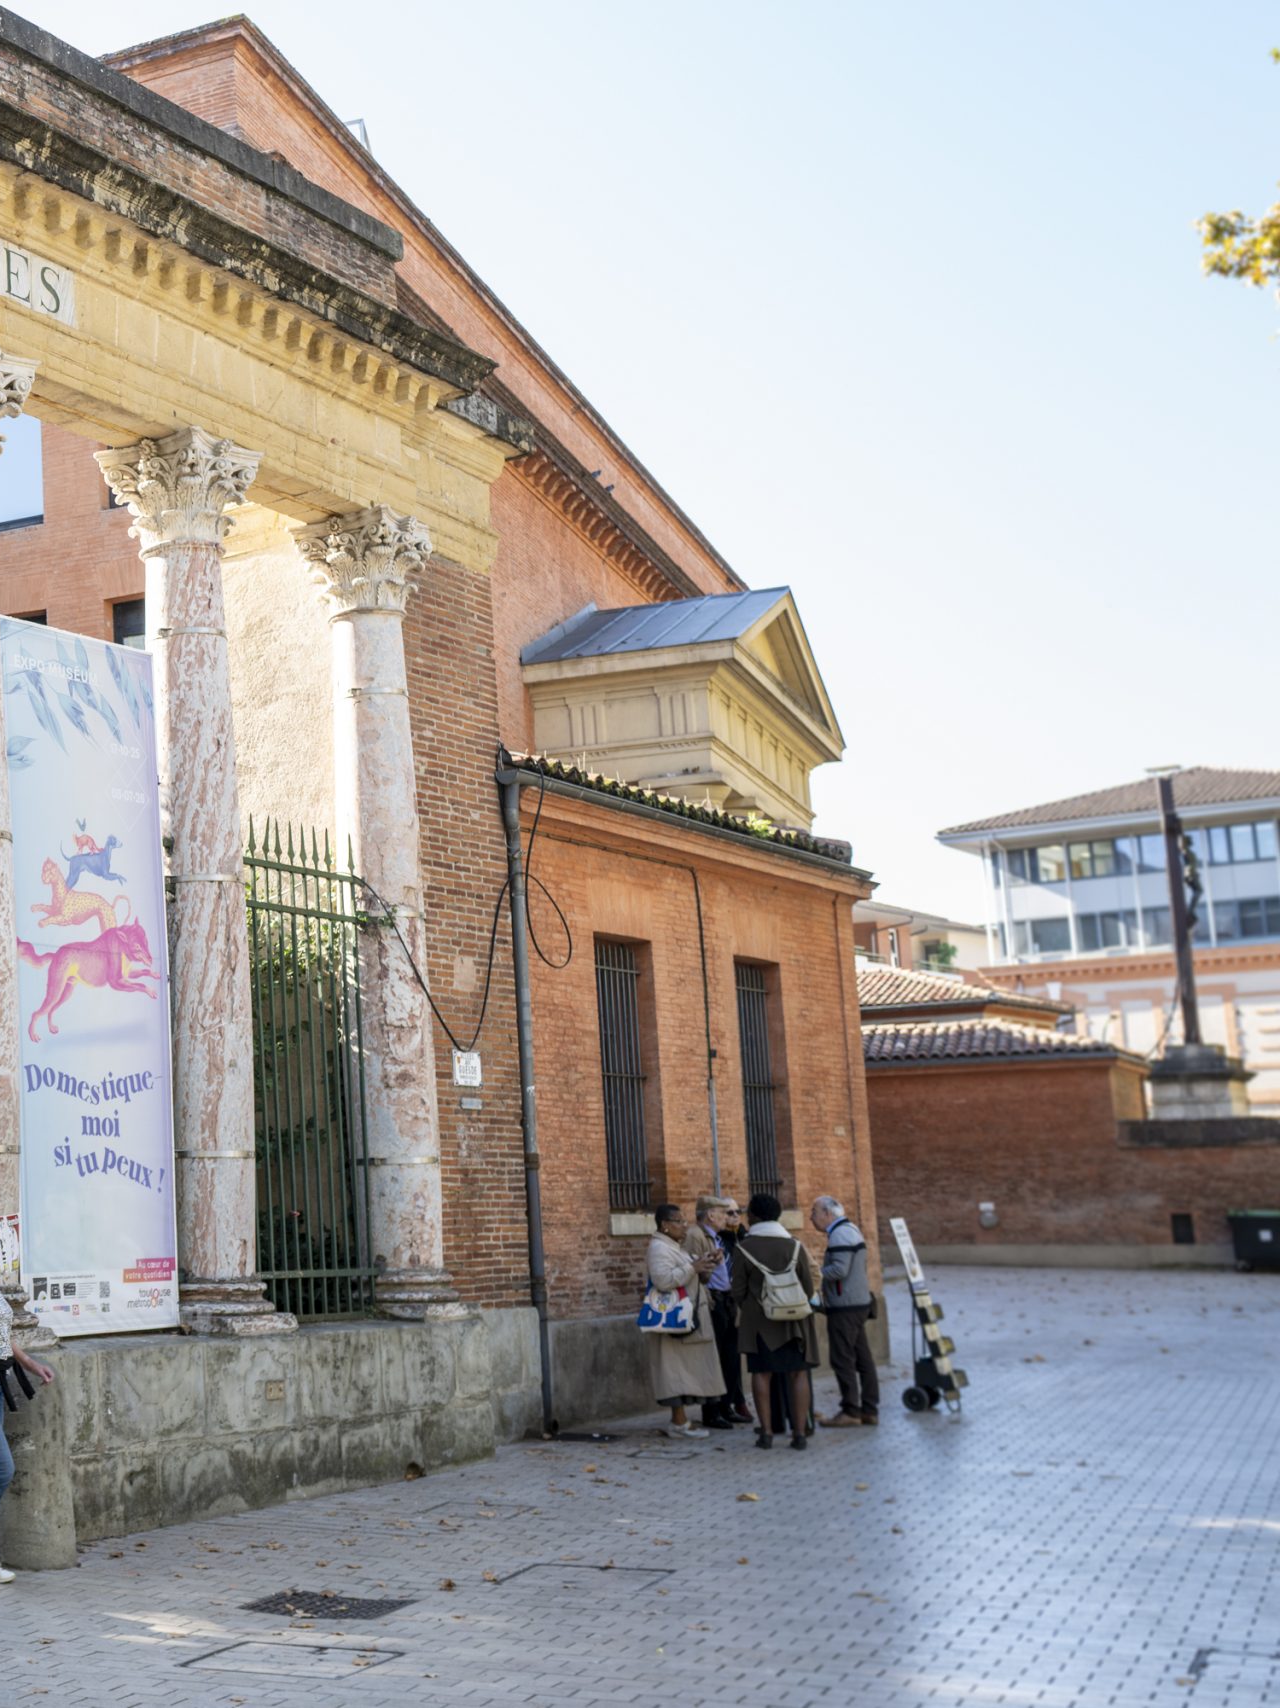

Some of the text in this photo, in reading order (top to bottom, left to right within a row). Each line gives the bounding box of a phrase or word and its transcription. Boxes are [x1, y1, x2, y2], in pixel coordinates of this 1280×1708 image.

[81, 1109, 121, 1138] moi
[53, 1136, 73, 1168] si
[75, 1151, 100, 1178] tu
[101, 1147, 154, 1189] peux
